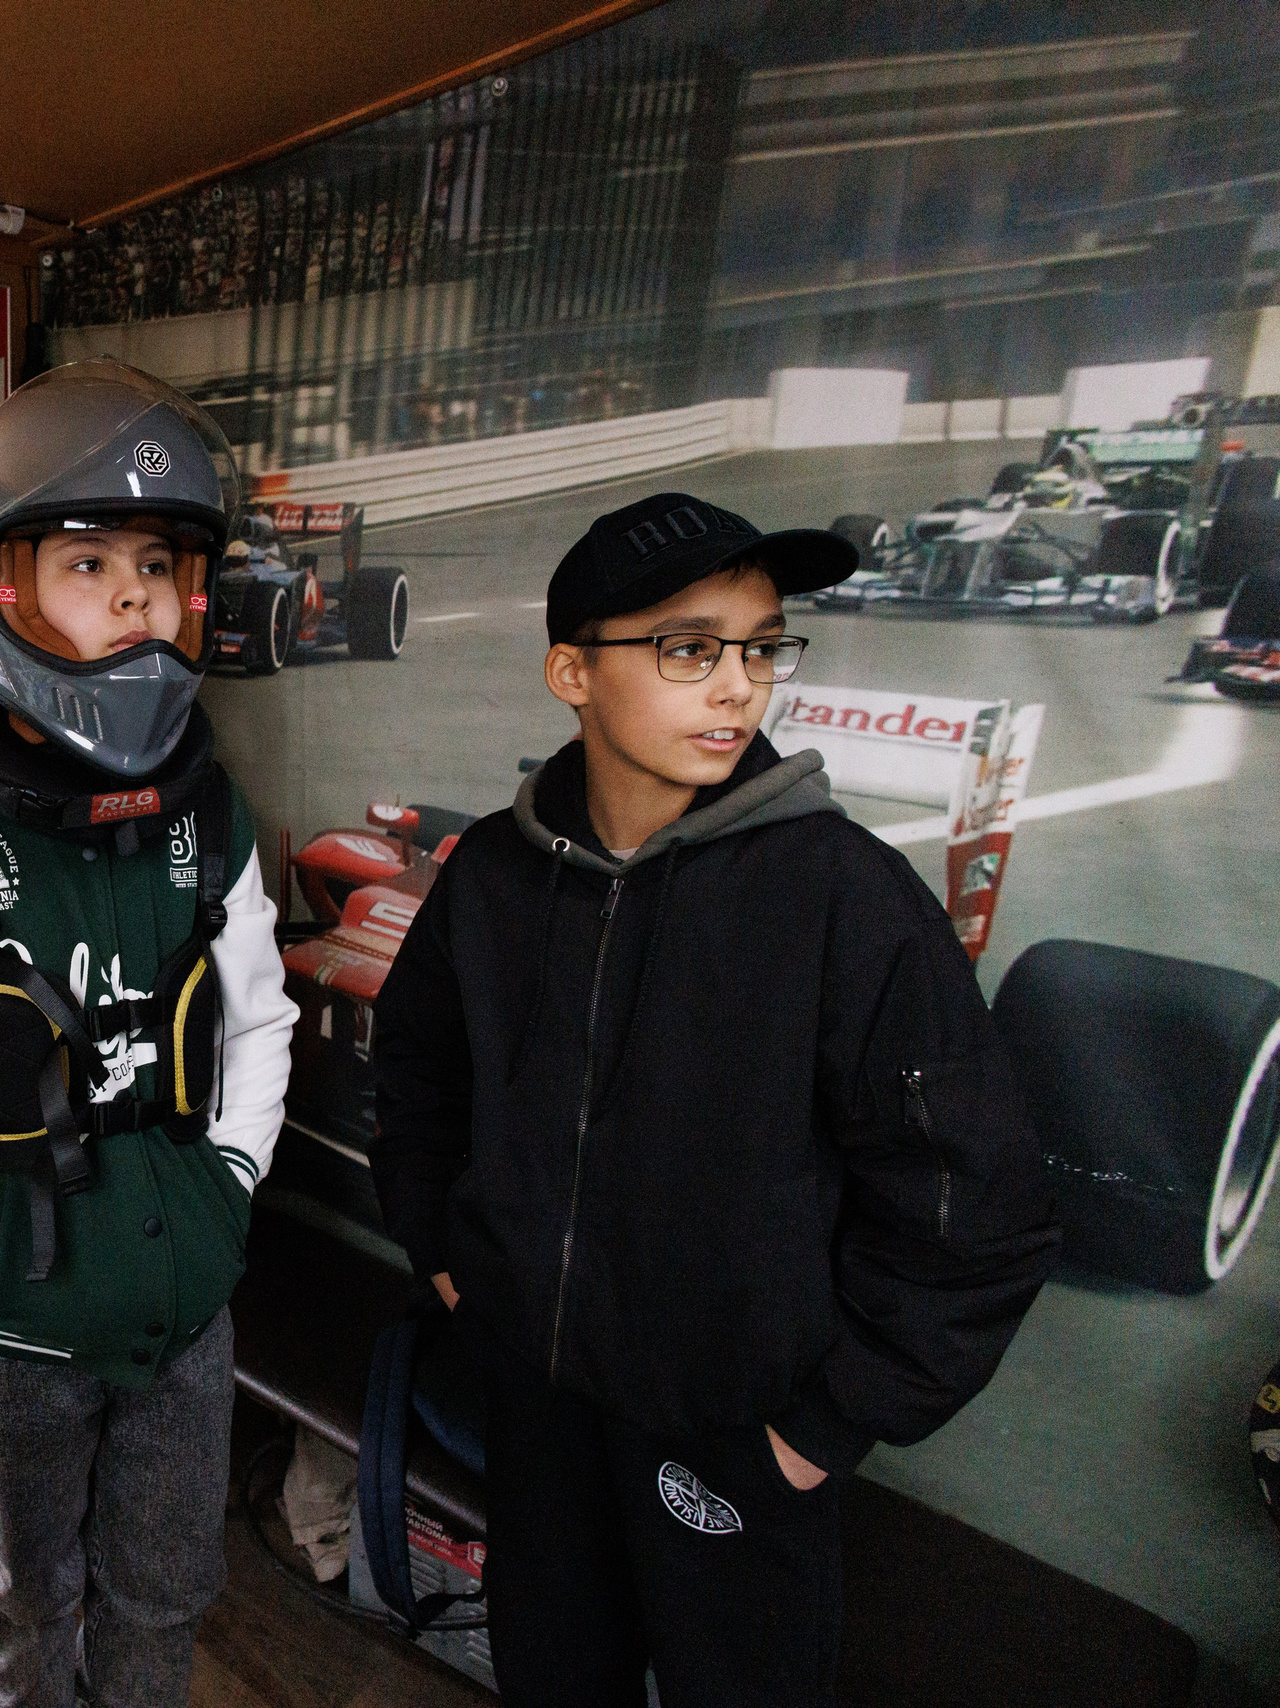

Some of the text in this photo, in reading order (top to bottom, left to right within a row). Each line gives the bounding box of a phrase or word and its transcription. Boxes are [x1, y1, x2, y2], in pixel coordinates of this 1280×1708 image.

[98, 791, 154, 812] RLG
[100, 805, 154, 818] RACE WEAR
[664, 1483, 698, 1523] ISLAND
